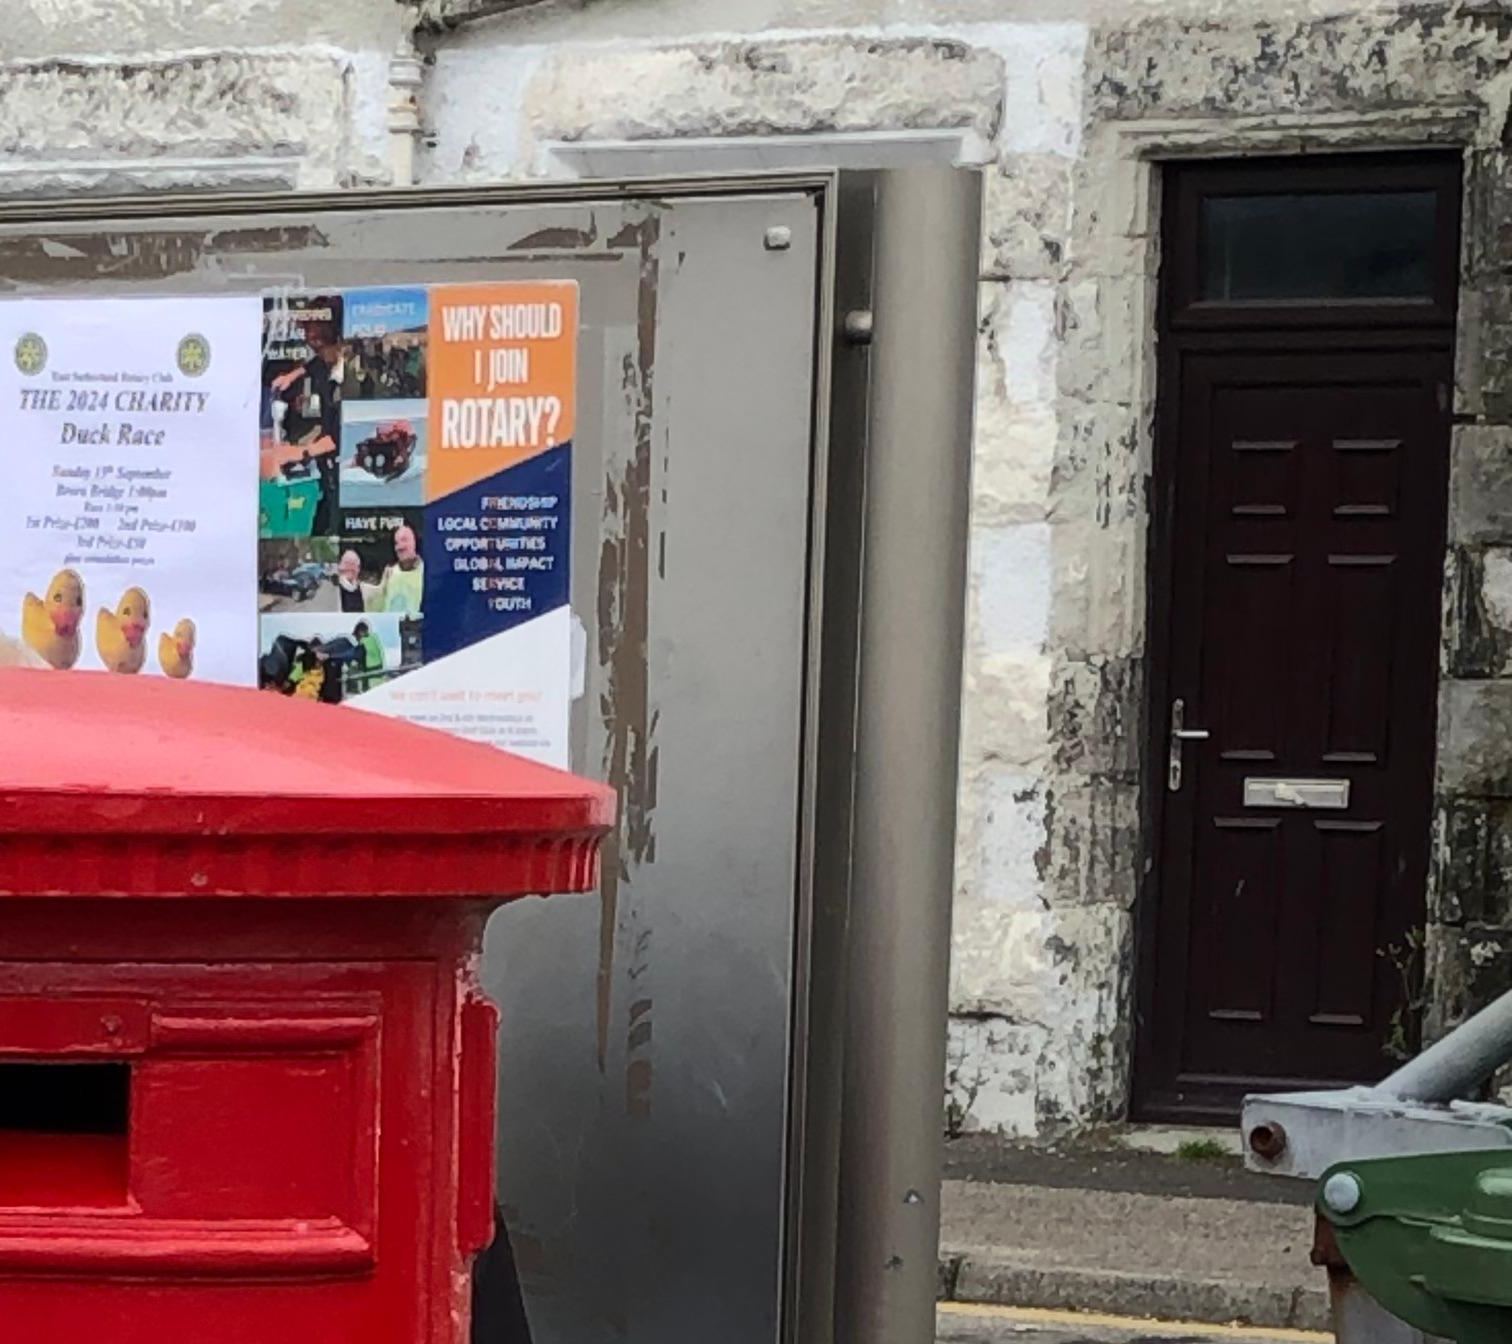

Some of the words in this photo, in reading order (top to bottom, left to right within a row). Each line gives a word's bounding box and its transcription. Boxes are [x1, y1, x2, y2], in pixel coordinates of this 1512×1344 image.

[441, 305, 487, 342] WHY
[489, 303, 562, 340] SHOULD
[474, 350, 482, 385] I
[487, 348, 529, 393] JOIN
[19, 389, 61, 411] THE
[65, 389, 109, 412] 2024
[113, 390, 210, 413] CHARITY
[441, 395, 562, 449] ROTARY?
[60, 422, 112, 446] Duck
[117, 423, 166, 446] Race
[480, 496, 558, 511] FRIENDSHIP
[345, 516, 377, 530] HAVE
[380, 516, 404, 530] FUN
[437, 517, 478, 531] LOCAL
[480, 516, 559, 531] COMMUNITY
[444, 536, 546, 551] OPPORTUNITIES
[453, 557, 503, 572] GLOBAL
[505, 556, 555, 571] IMPACT
[472, 576, 526, 592] SERVICE
[487, 596, 532, 611] YOUTH
